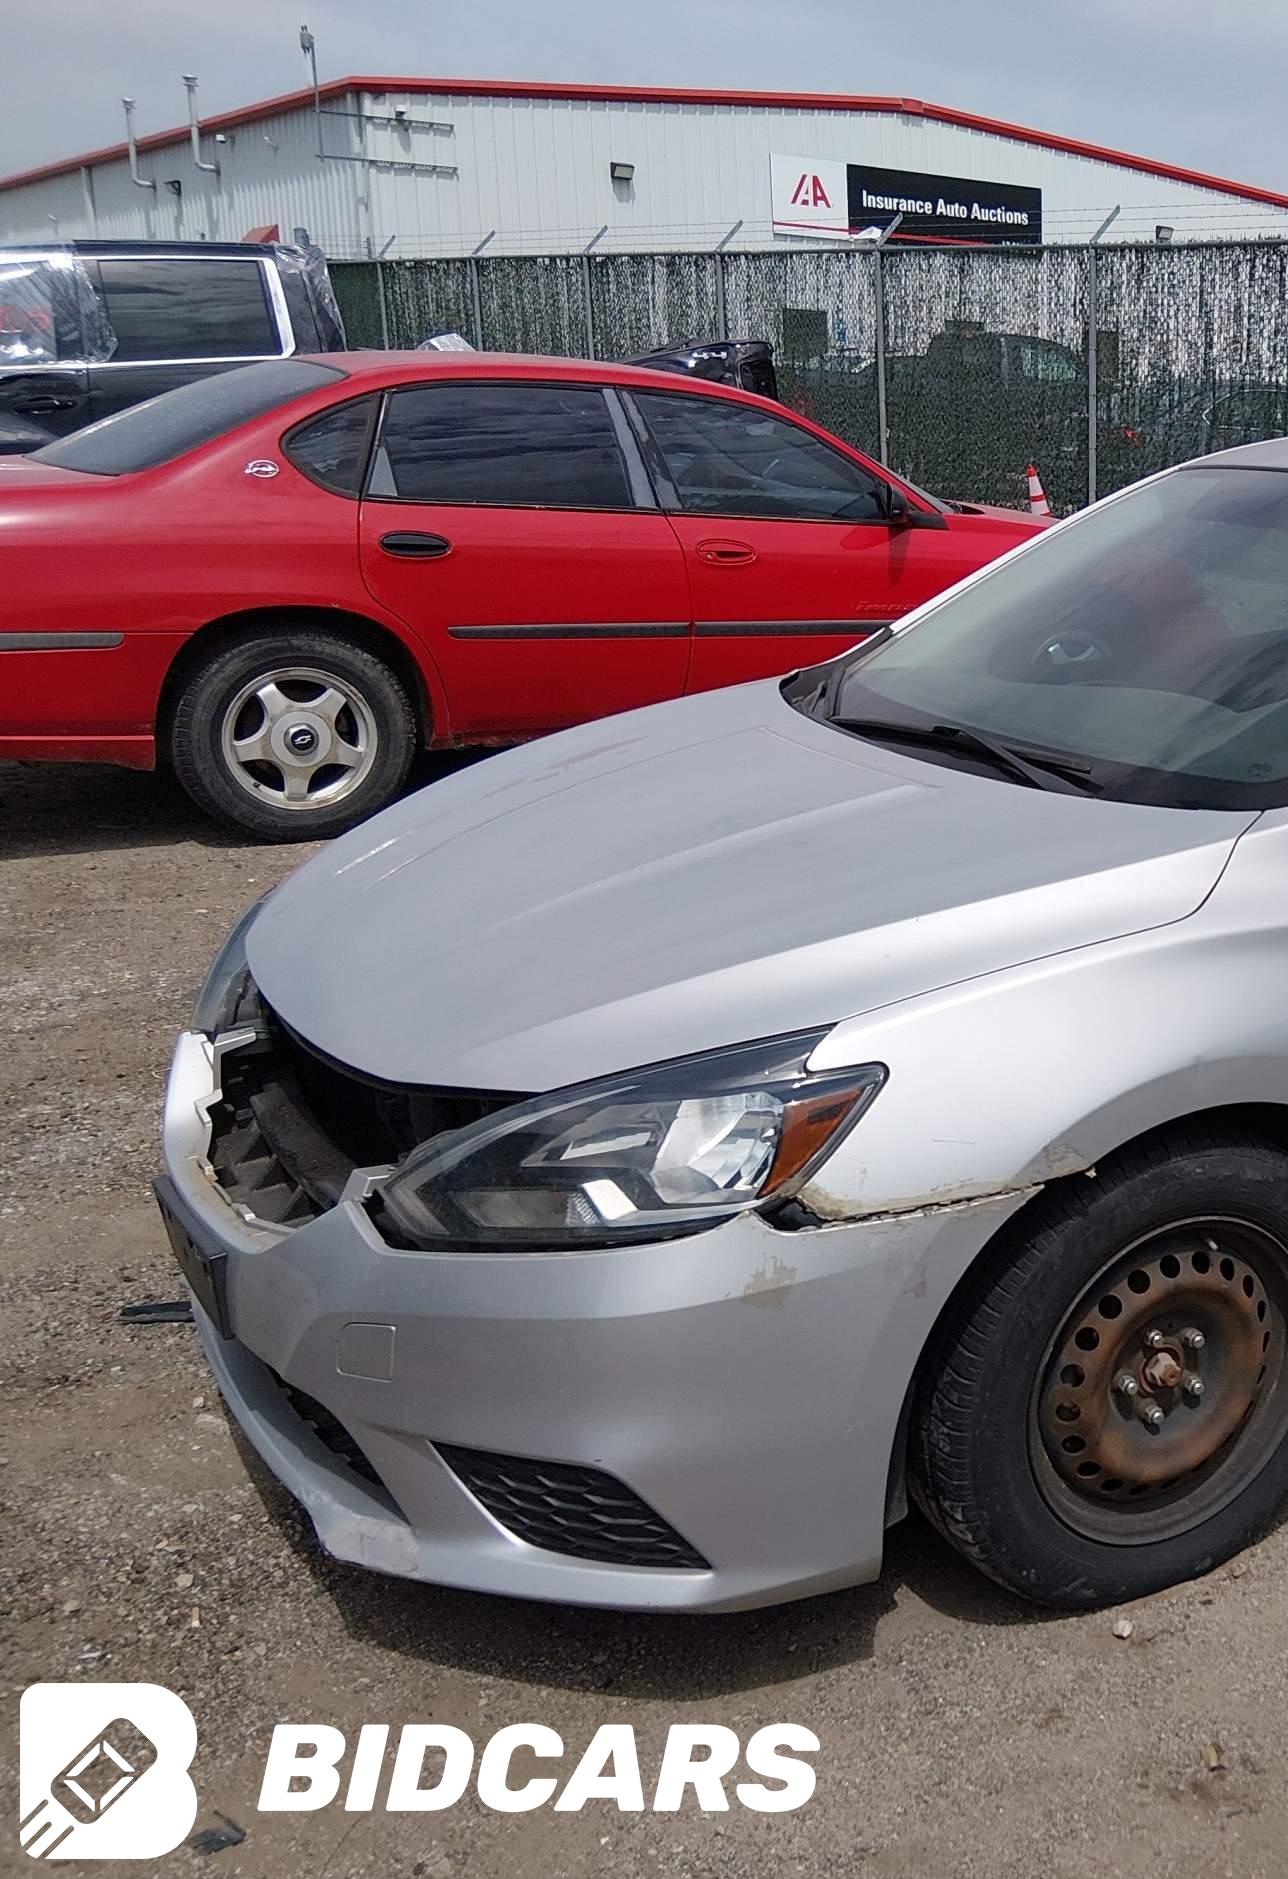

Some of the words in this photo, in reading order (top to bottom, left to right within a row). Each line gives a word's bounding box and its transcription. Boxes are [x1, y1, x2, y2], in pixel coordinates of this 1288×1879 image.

[862, 189, 933, 215] Insurance
[936, 199, 967, 219] Auto
[971, 203, 1029, 226] Auctions
